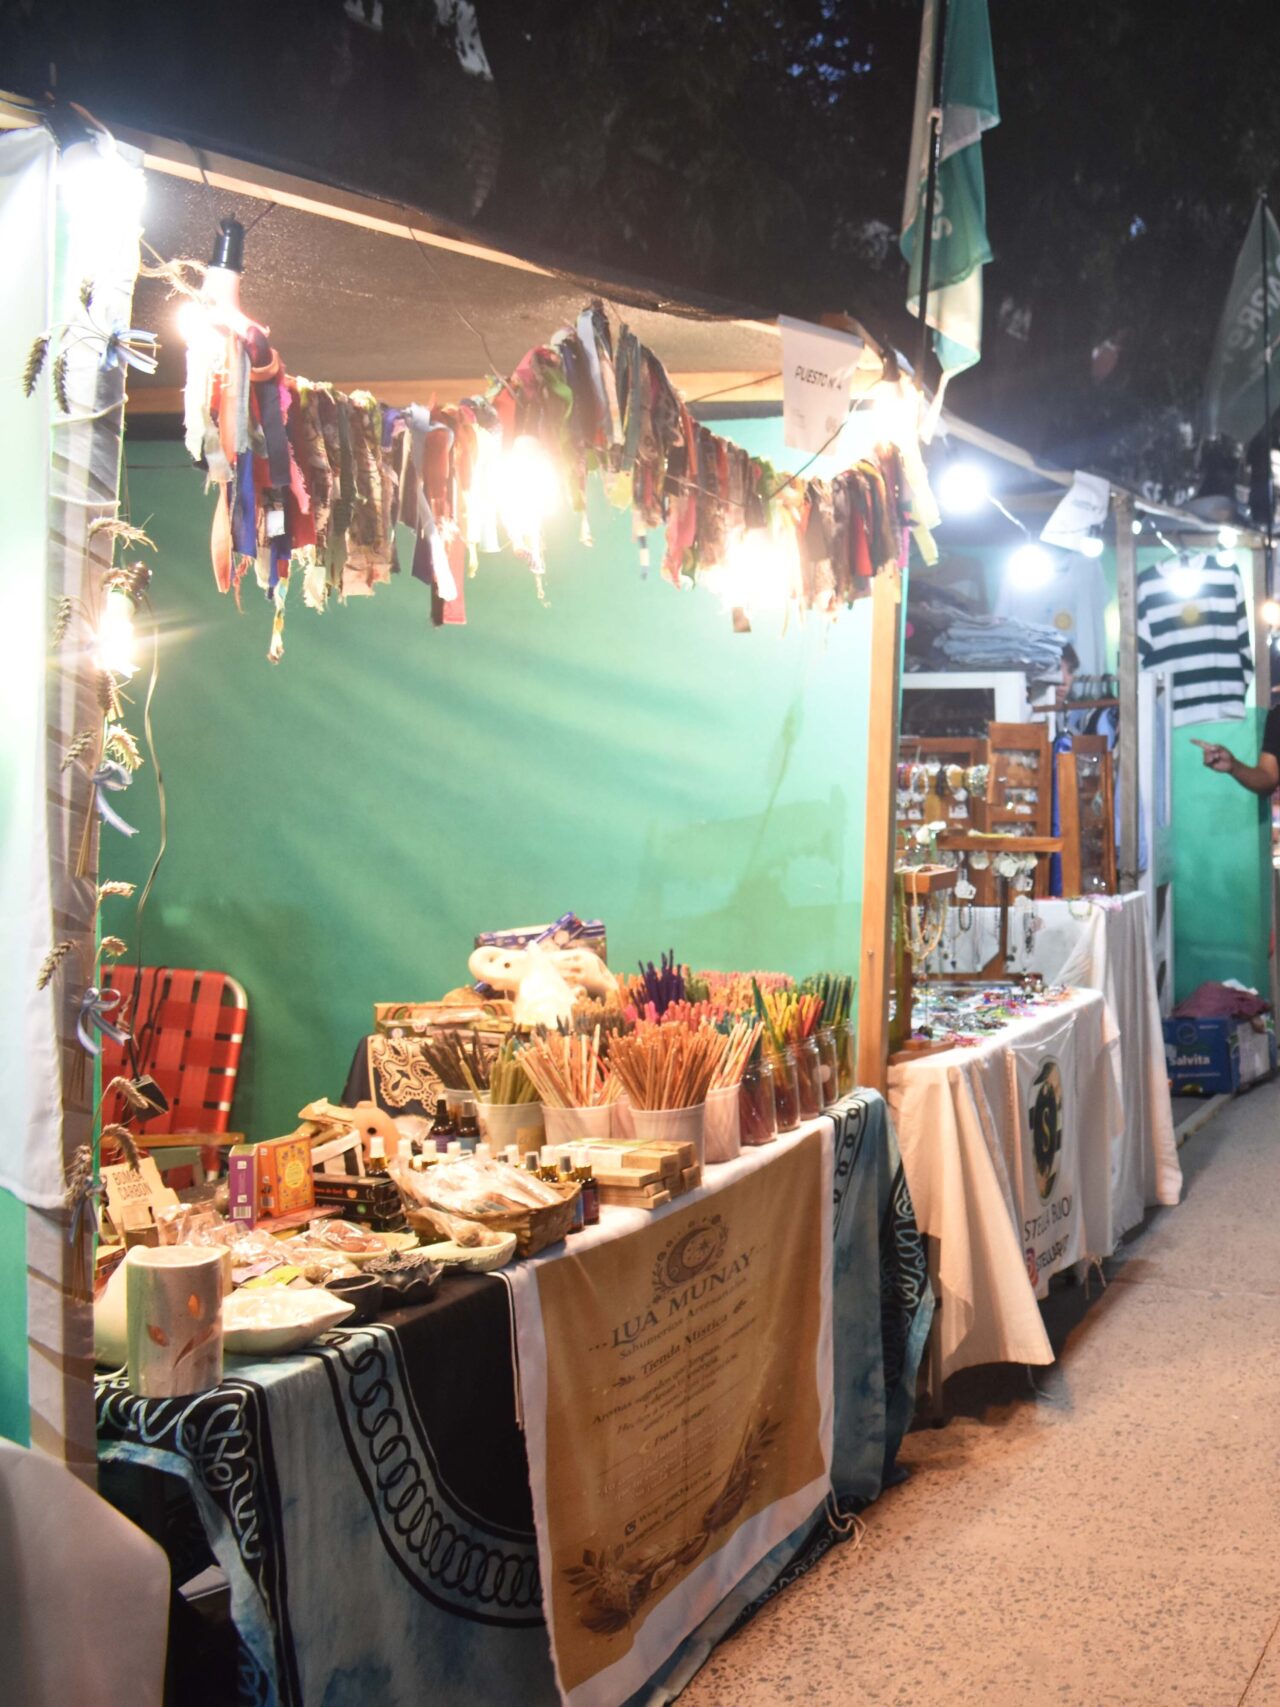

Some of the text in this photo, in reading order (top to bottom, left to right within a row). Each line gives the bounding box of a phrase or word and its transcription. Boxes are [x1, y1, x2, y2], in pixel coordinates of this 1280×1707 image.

[794, 365, 828, 387] PUESTO
[610, 1247, 753, 1349] LUA MUNAY
[619, 1318, 683, 1360] Sahumerios
[641, 1344, 681, 1376] Tienda
